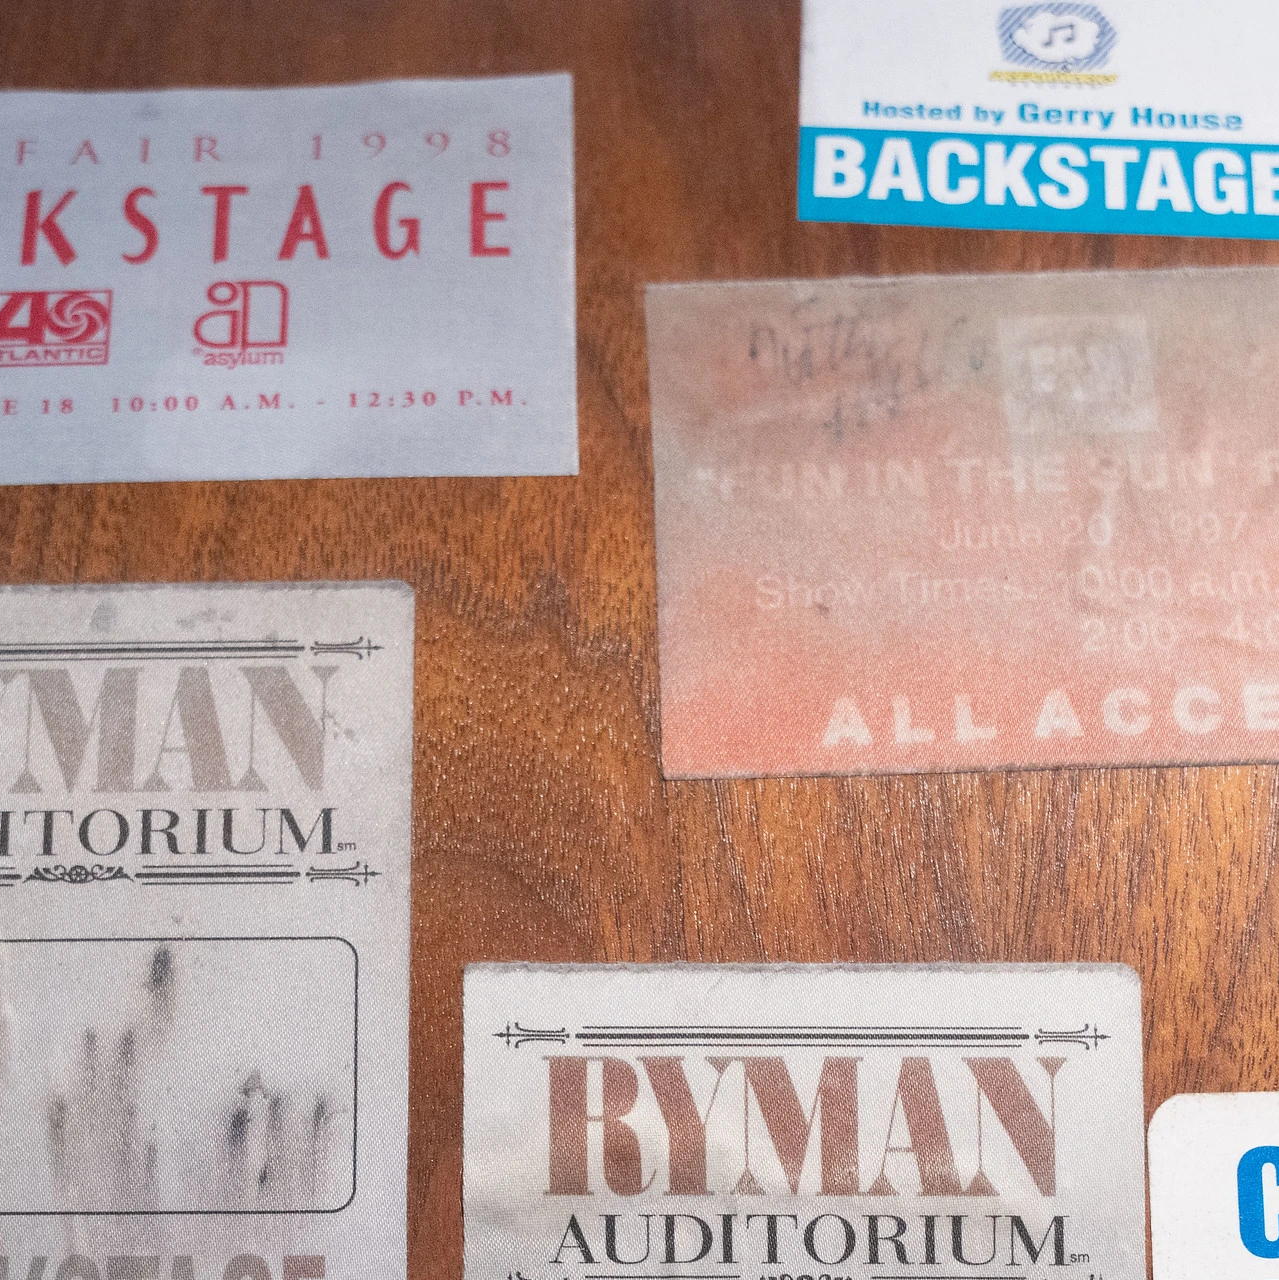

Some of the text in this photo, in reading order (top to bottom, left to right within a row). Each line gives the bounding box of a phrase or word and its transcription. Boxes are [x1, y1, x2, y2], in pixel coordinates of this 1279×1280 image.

[863, 100, 1244, 131] Hosted by Gerry House
[15, 136, 223, 167] FAIR
[310, 129, 513, 161] 1998
[203, 351, 285, 370] asylum
[42, 397, 75, 415] 18
[112, 396, 199, 413] 10:00
[220, 393, 295, 411] A.M.
[349, 391, 437, 408] 12:30
[458, 389, 527, 407] P.M.
[866, 458, 928, 499] IN
[948, 456, 1070, 493] THE
[940, 519, 1044, 551] June
[756, 572, 863, 610] Show
[822, 697, 996, 749] ALL
[542, 1054, 1068, 1197] RYMAN
[549, 1212, 1071, 1267] AUDITORIUM
